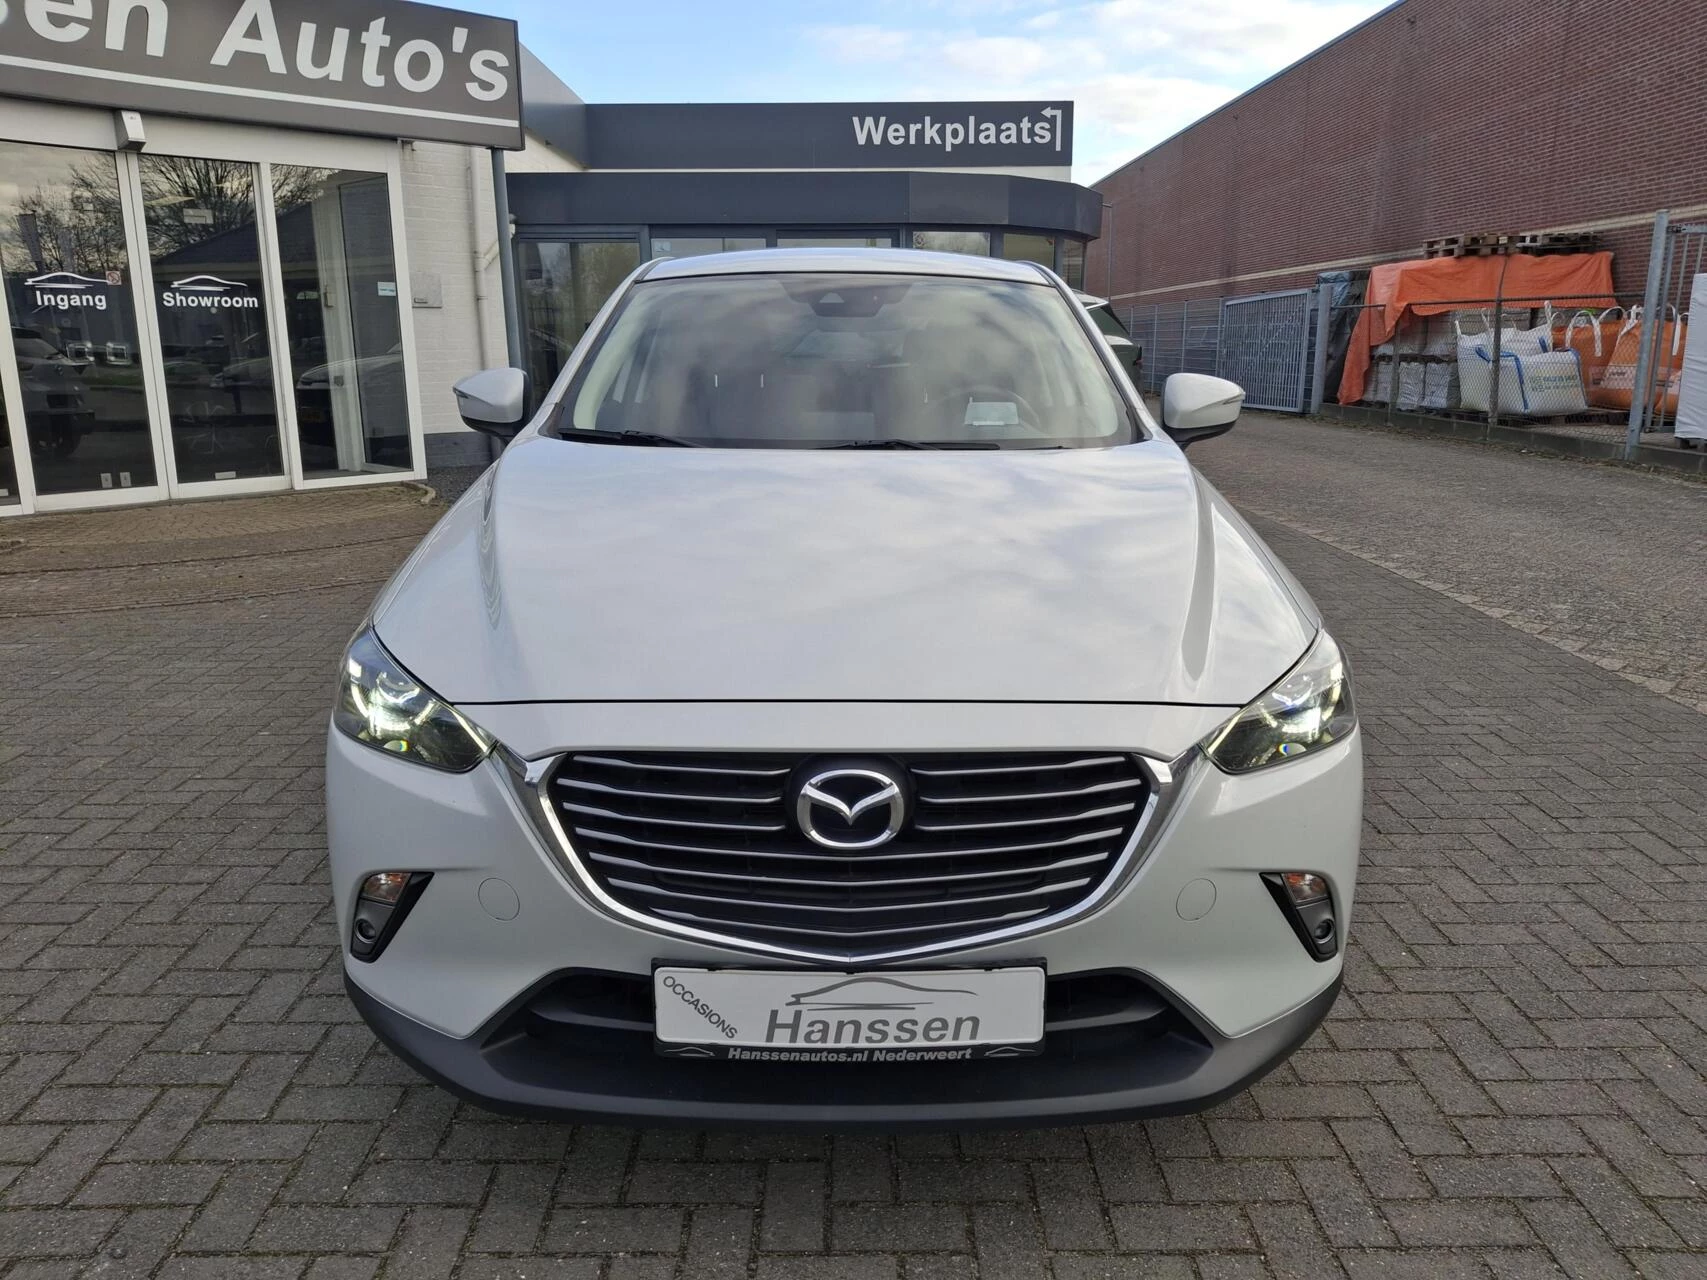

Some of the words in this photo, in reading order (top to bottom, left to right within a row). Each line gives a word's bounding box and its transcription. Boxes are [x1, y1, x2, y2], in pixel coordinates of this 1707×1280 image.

[0, 0, 168, 57] en
[209, 0, 510, 102] Auto's
[852, 115, 1052, 152] Werkplaats
[35, 290, 107, 309] Ingang
[162, 292, 259, 308] Showroom
[662, 975, 738, 1039] OCCASIONS
[765, 1009, 981, 1045] Hanssen
[727, 1047, 868, 1063] Hanssenautos.nl
[872, 1048, 972, 1062] Nederweert
